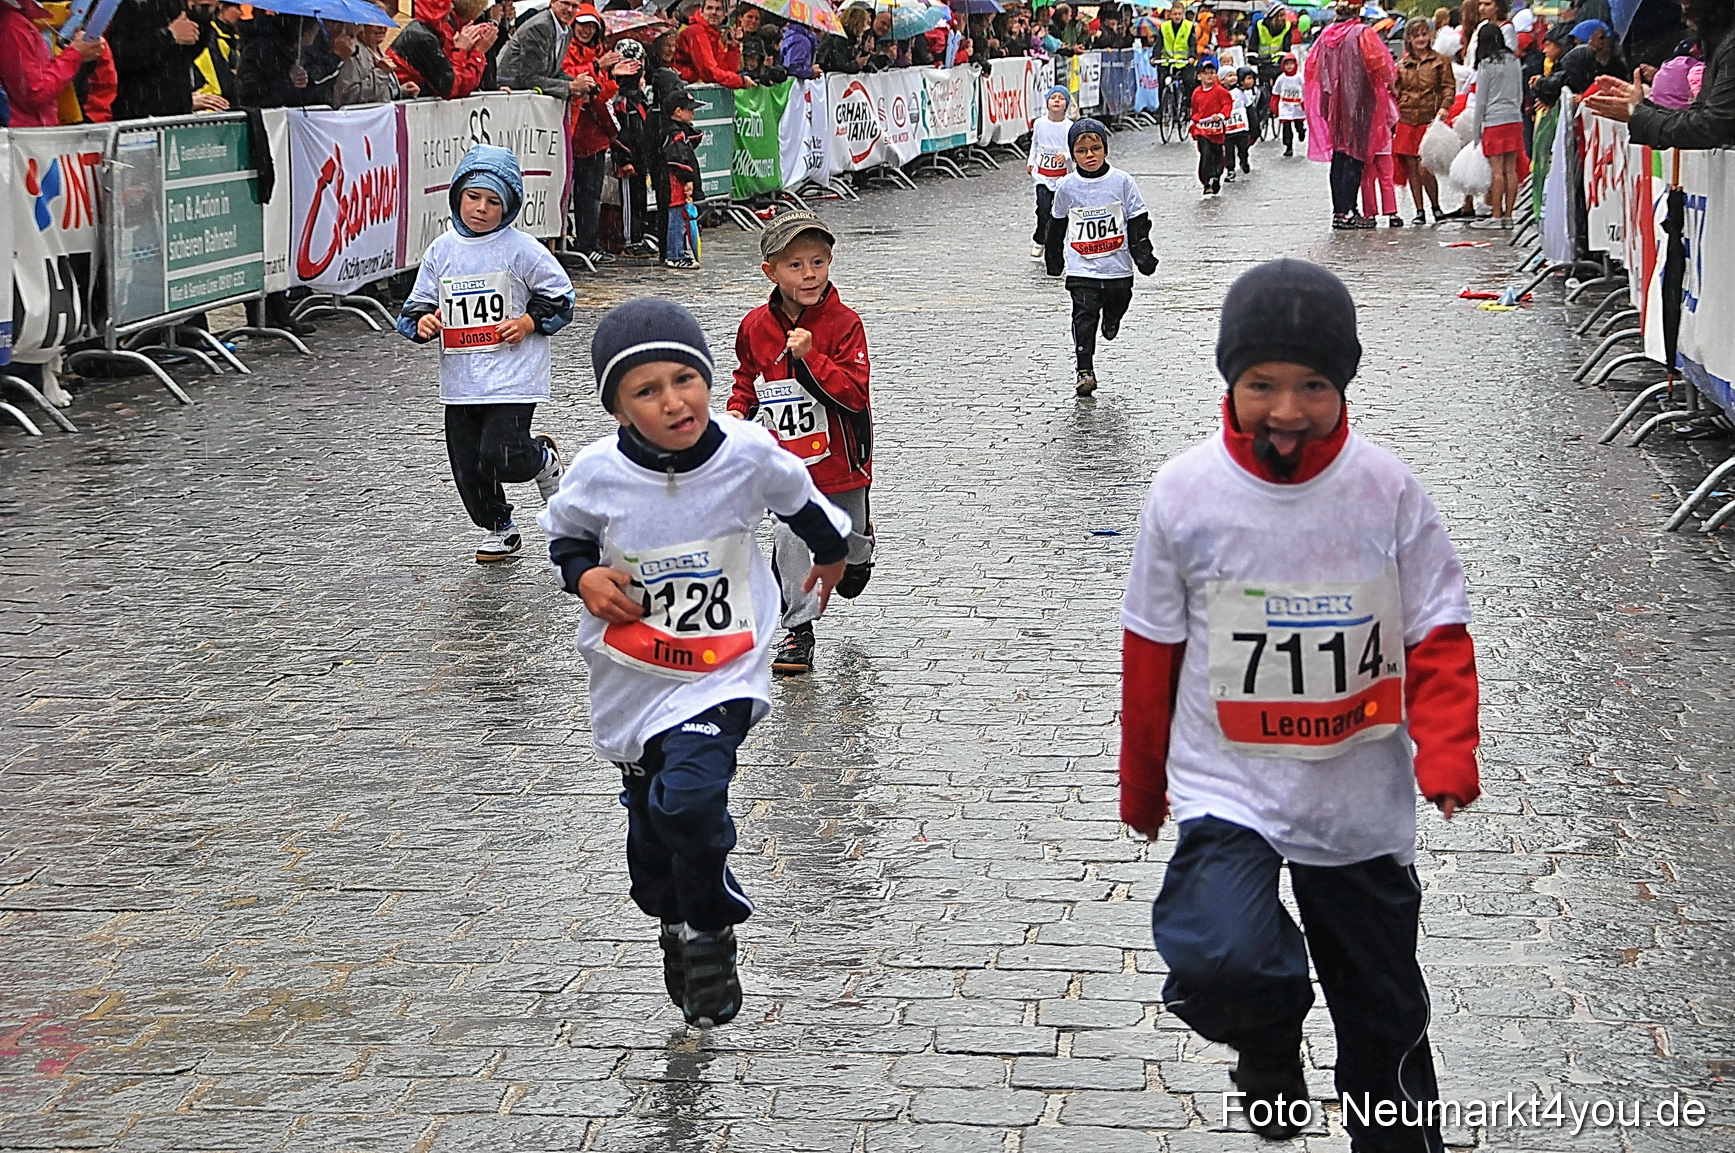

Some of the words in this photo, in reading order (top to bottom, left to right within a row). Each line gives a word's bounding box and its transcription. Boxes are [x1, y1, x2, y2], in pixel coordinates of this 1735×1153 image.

[423, 136, 466, 169] RECHTS
[168, 198, 185, 224] Fun
[186, 195, 194, 221] &
[194, 191, 221, 219] Action
[221, 189, 230, 214] in
[170, 232, 204, 261] sicheren
[205, 224, 237, 254] Bahnen!
[1076, 217, 1118, 241] 7064
[1078, 240, 1118, 254] Sebastian
[451, 279, 486, 291] BOCK
[445, 293, 504, 326] 7149
[459, 331, 493, 345] Jonas
[641, 551, 709, 576] BOCK
[1265, 595, 1354, 616] BOCK
[652, 637, 693, 666] Tim
[1232, 620, 1384, 695] 7114
[681, 723, 712, 735] JAKO
[1260, 698, 1366, 738] Leonard
